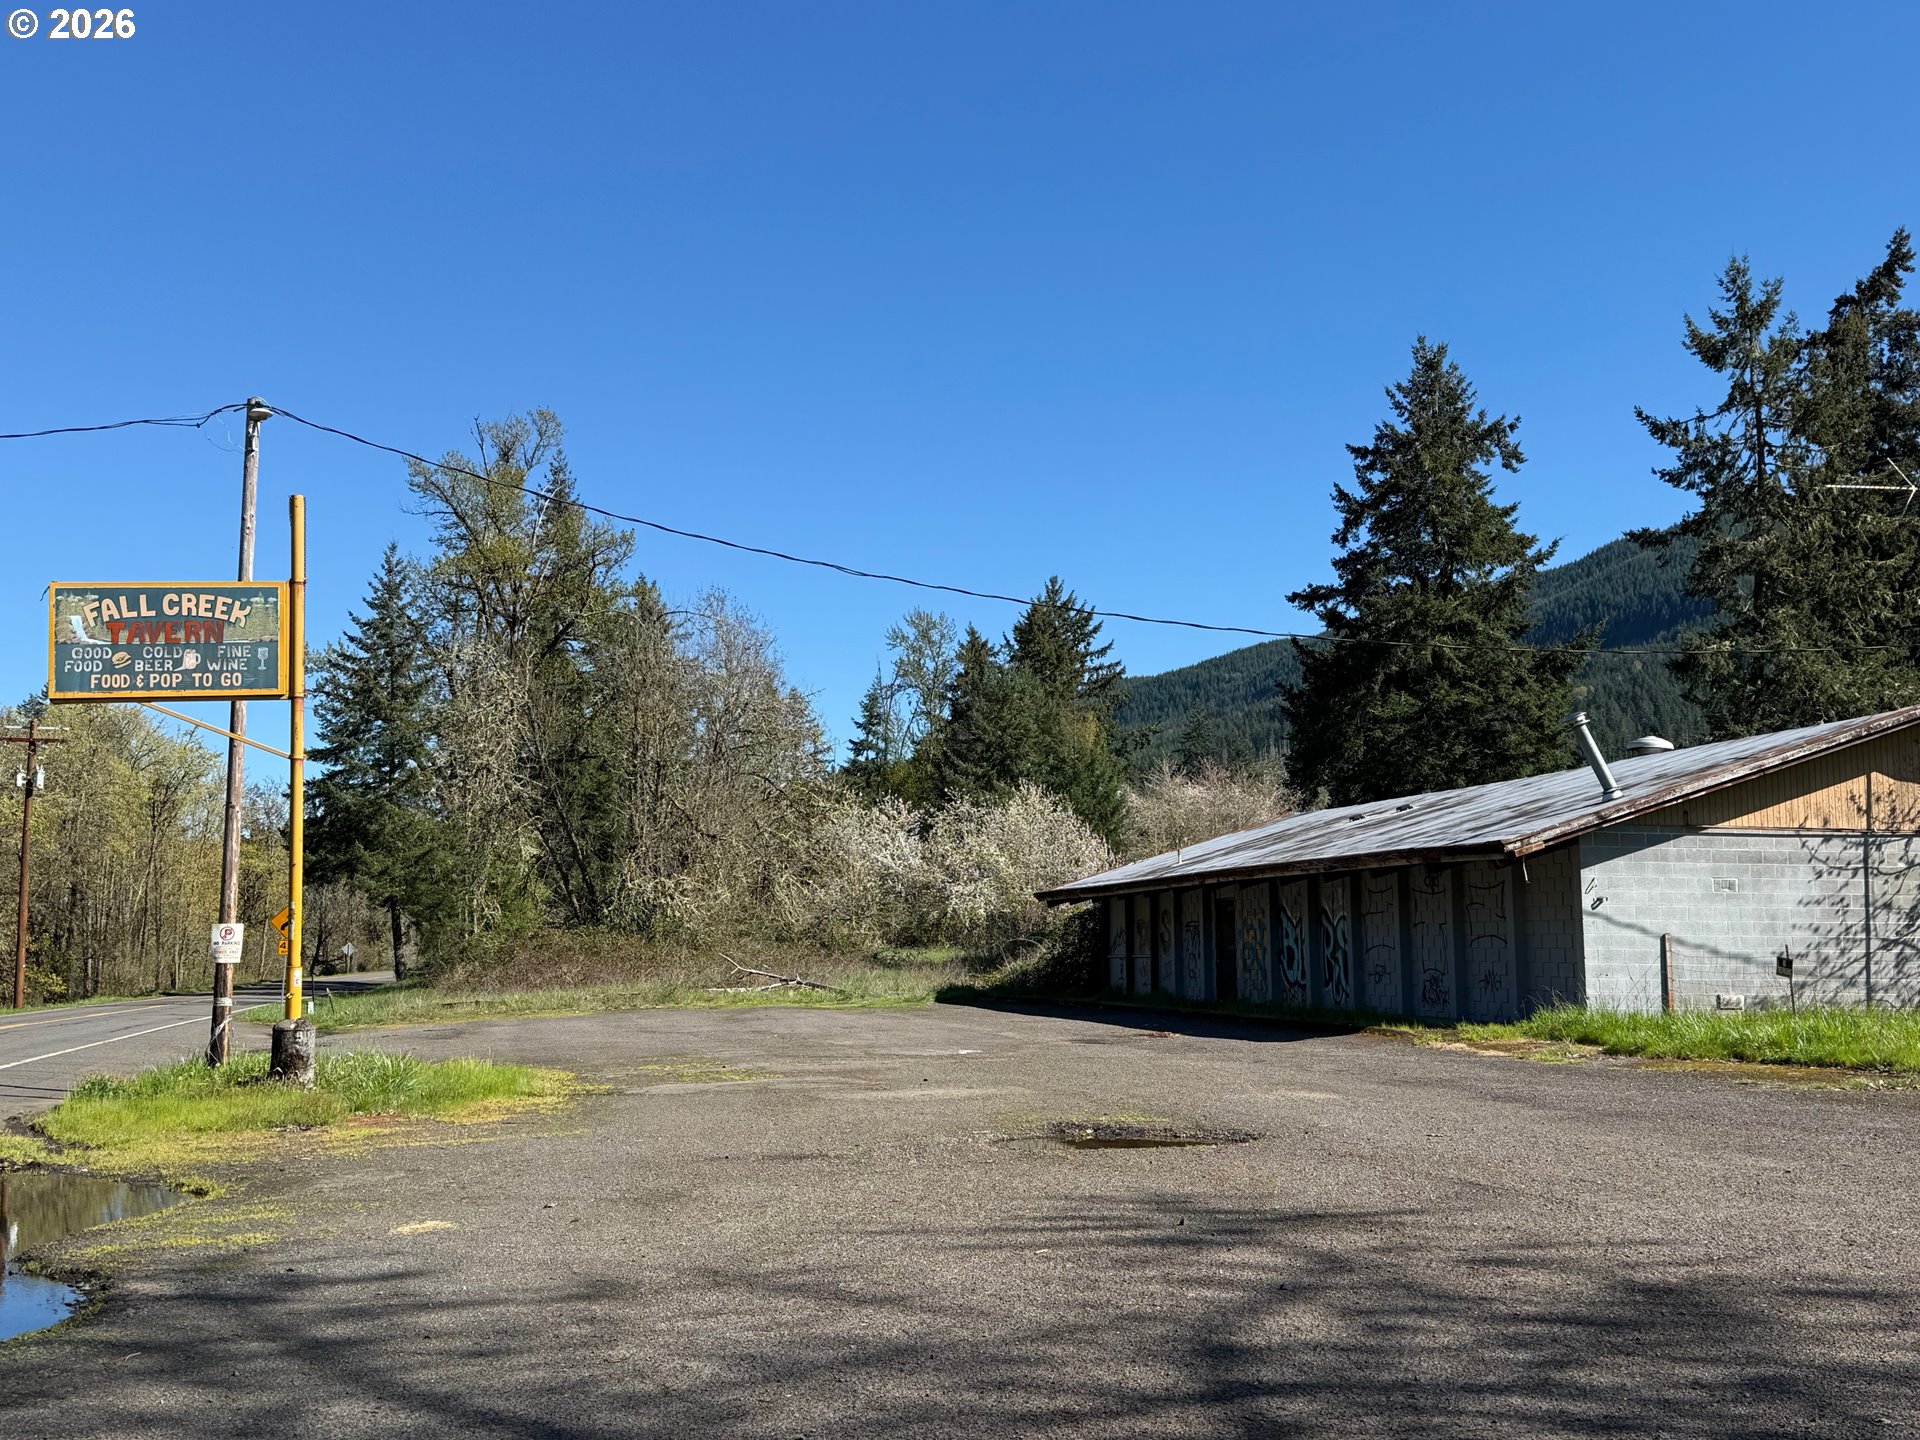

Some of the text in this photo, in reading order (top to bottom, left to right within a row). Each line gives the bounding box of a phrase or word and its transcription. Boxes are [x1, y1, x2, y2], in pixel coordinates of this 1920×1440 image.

[83, 593, 252, 628] FALL CREEK
[106, 620, 224, 644] TAVERN
[72, 646, 112, 659] GOOD
[142, 646, 183, 659] COLD
[217, 645, 251, 659] FINE
[64, 659, 103, 673] FOOD
[134, 659, 174, 672] BEER
[206, 658, 248, 671] WINE
[90, 672, 242, 689] FOOD & POP TO GO
